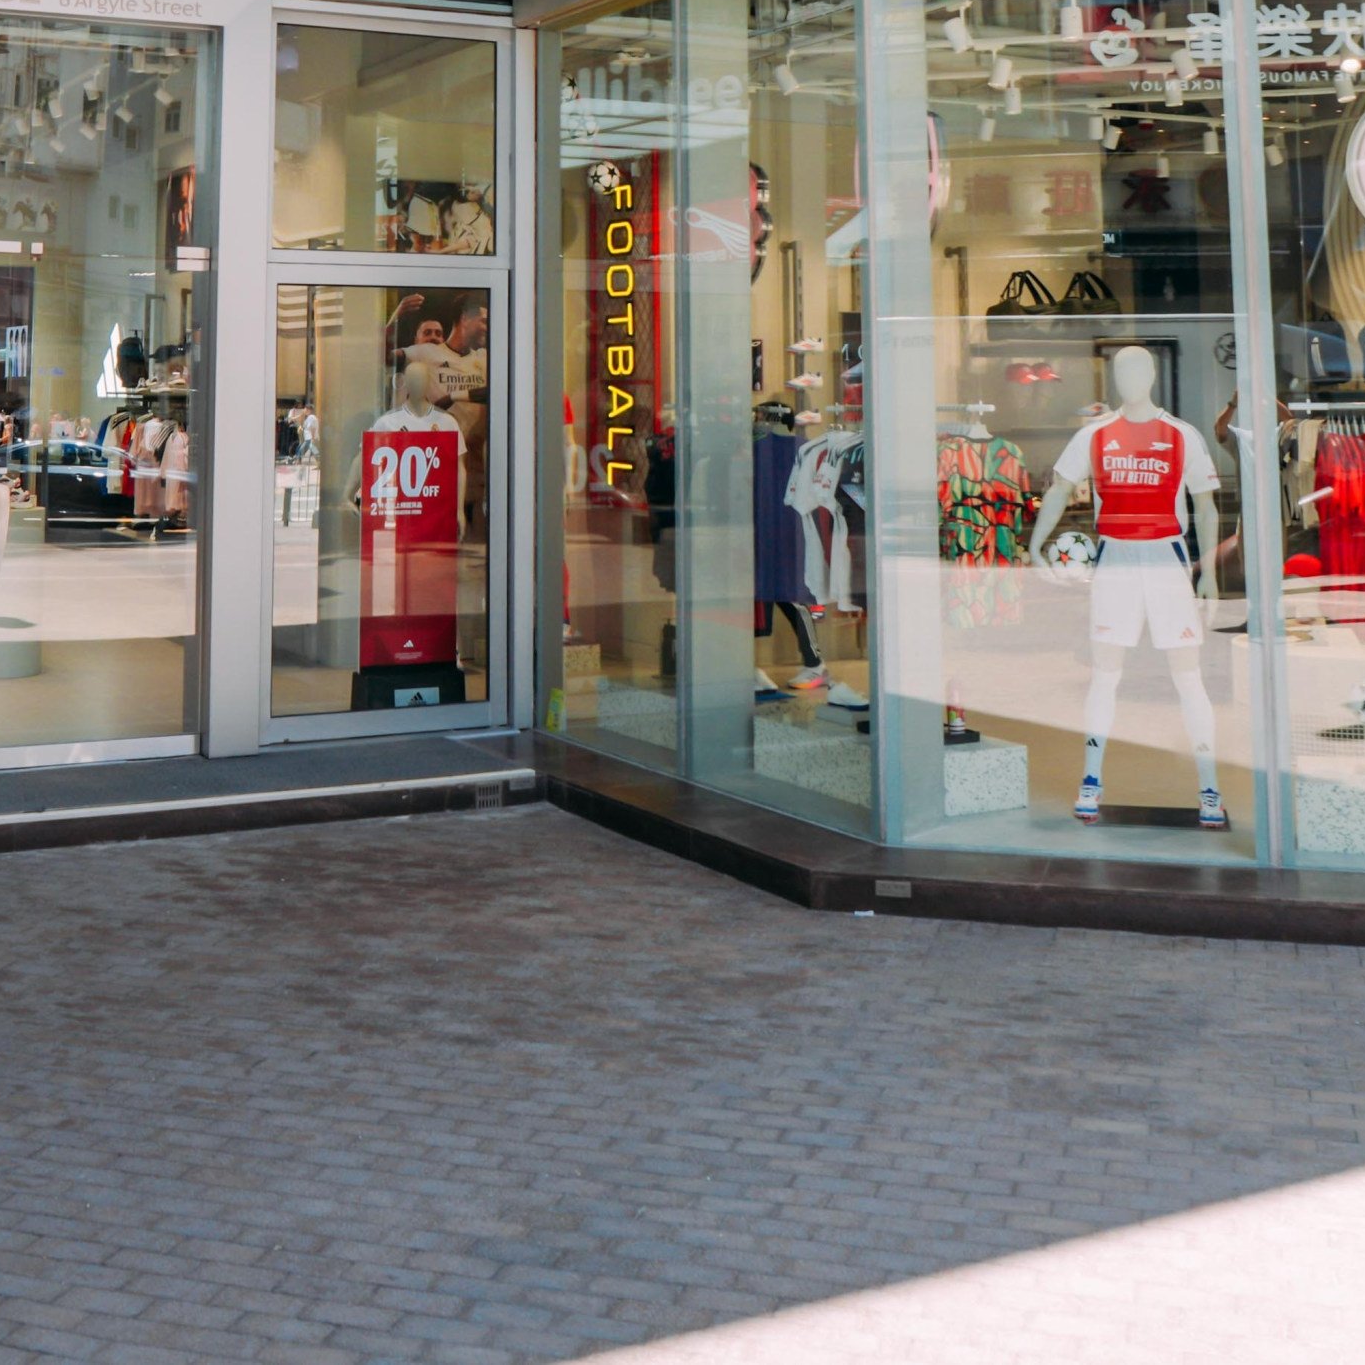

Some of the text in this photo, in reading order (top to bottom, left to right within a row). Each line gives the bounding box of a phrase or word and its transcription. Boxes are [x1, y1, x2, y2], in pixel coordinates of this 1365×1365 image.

[605, 183, 636, 488] FOOTBALL
[370, 446, 440, 498] 20%
[1104, 455, 1169, 474] Emirates
[423, 485, 440, 497] OFF
